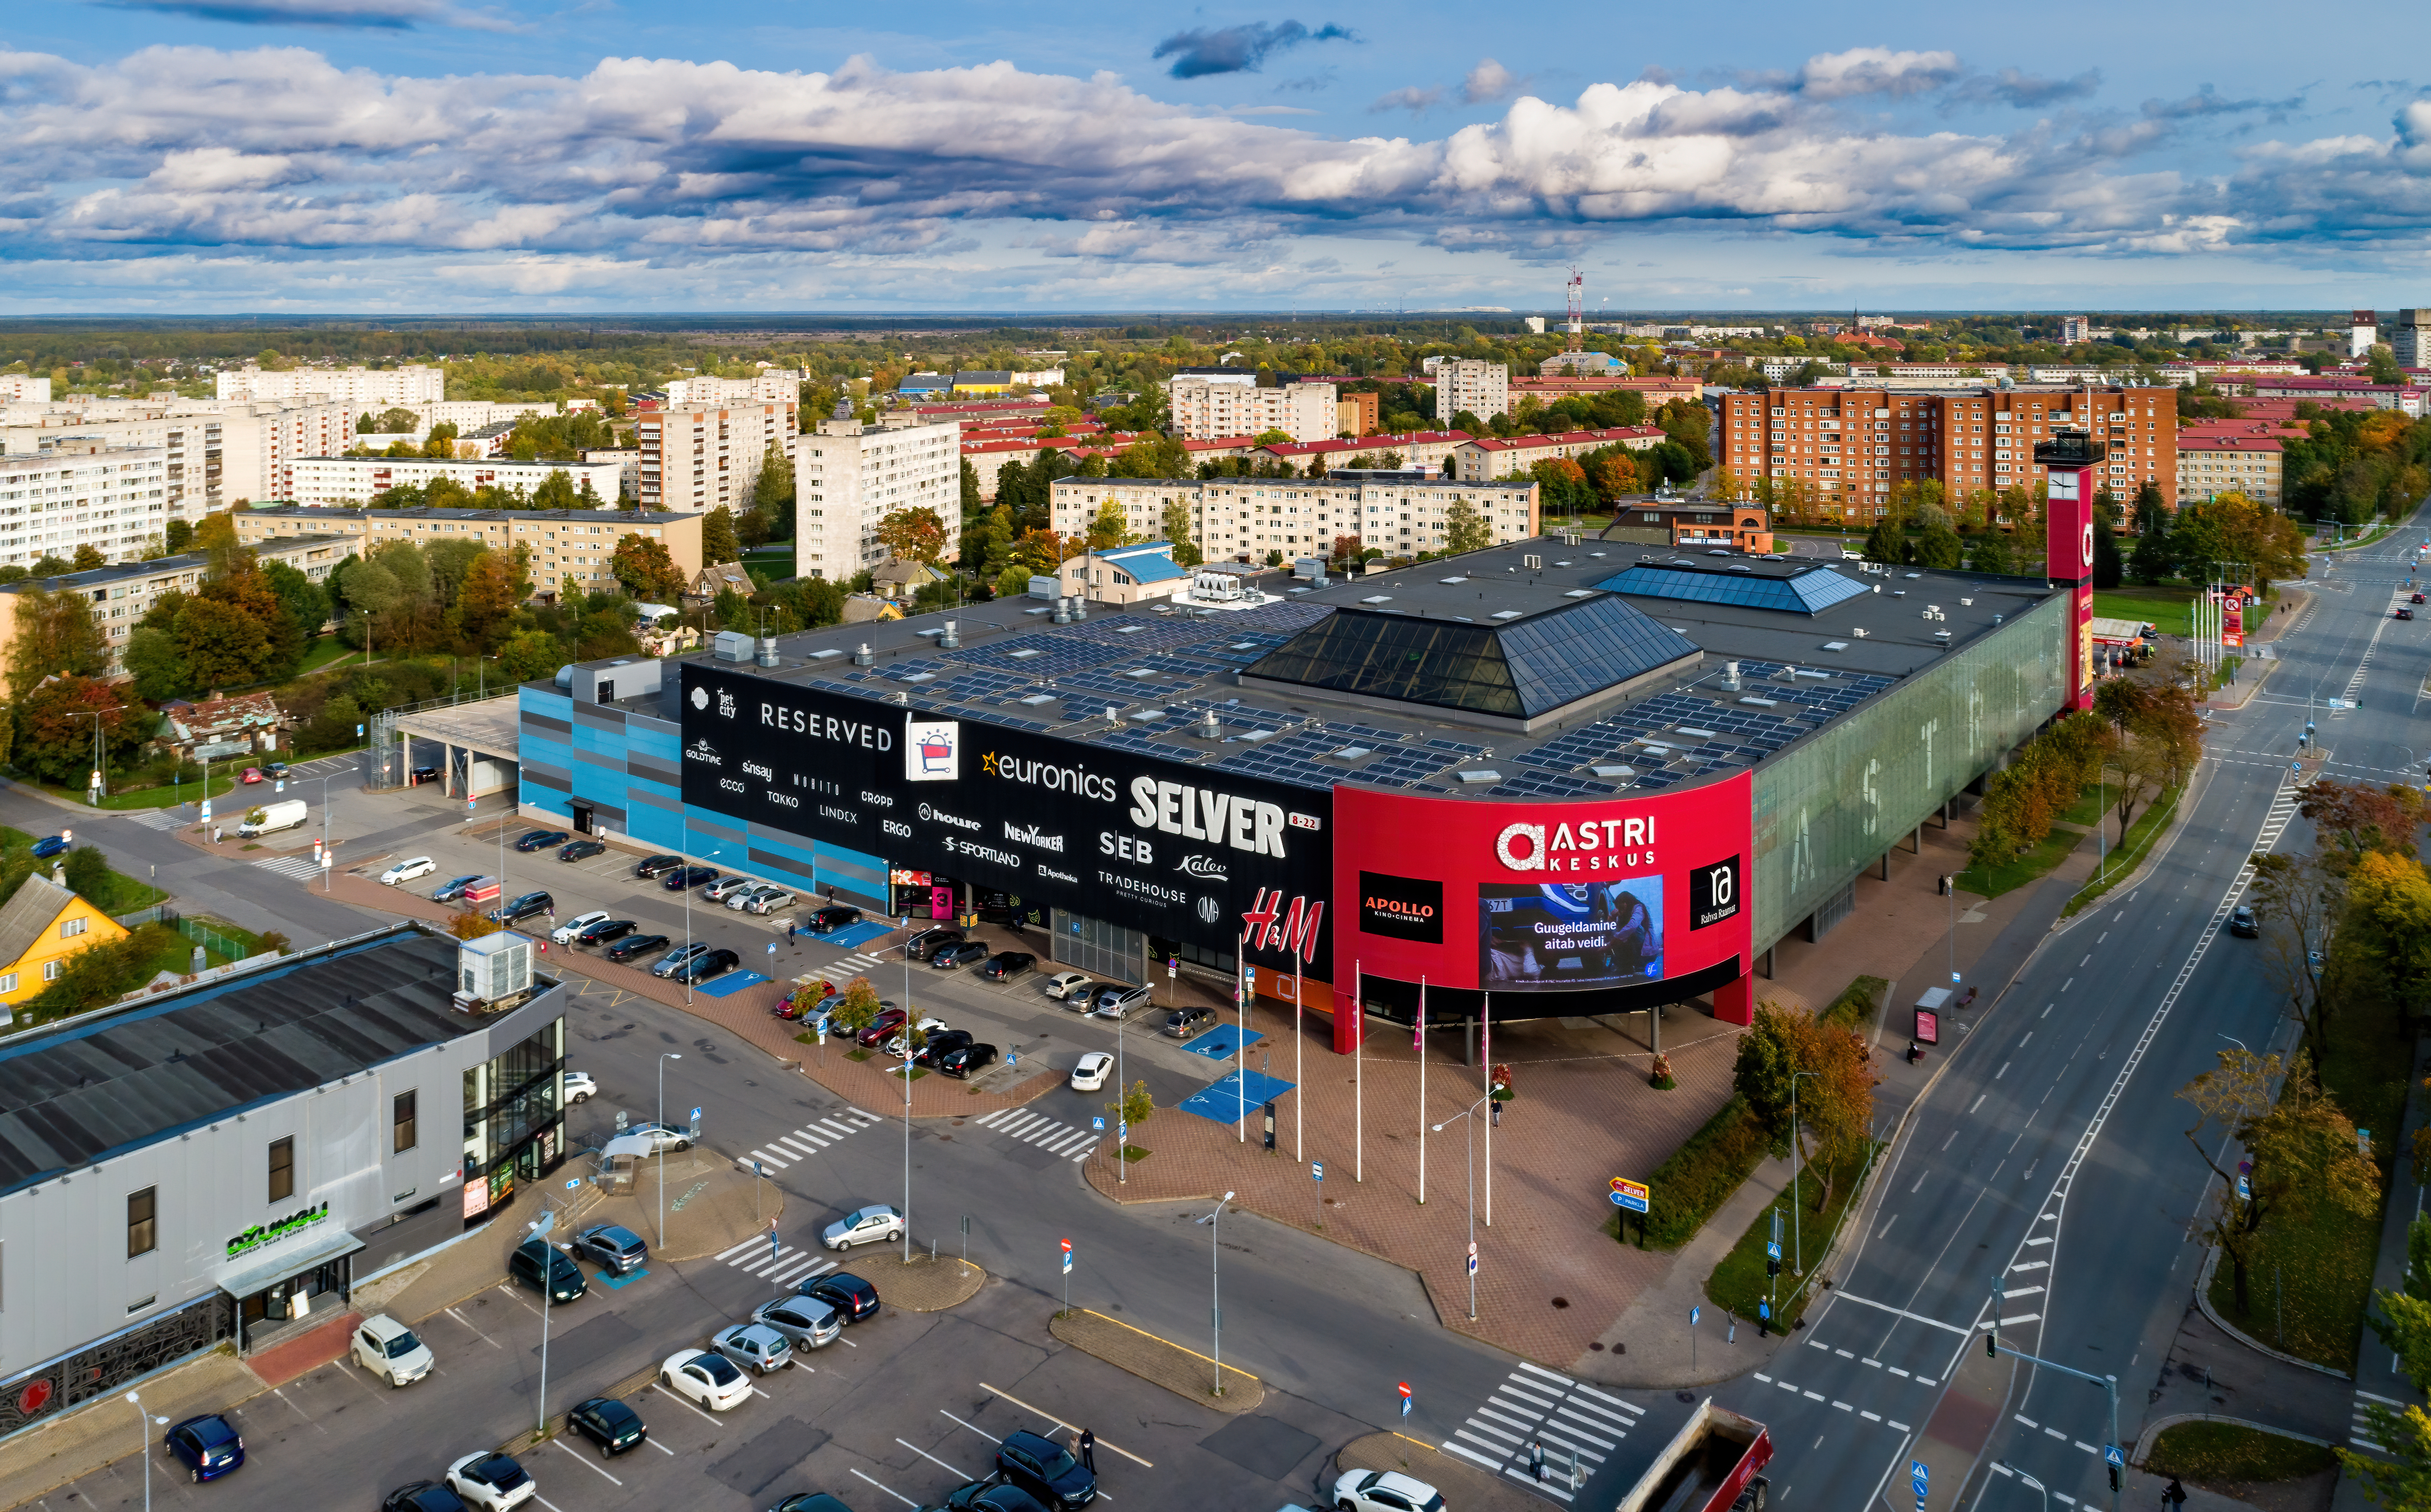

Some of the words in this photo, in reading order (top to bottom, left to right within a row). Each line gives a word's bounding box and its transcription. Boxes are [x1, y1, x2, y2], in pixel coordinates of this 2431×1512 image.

[720, 693, 733, 705] pet
[720, 704, 736, 718] city
[762, 703, 892, 751] RESERVED
[686, 749, 721, 765] GOLDTIME
[742, 760, 772, 782] sinsay
[999, 755, 1116, 802] euronics
[720, 778, 744, 793] ecco
[794, 774, 839, 796] MOHITO
[861, 791, 893, 808] CROPP
[820, 805, 857, 824] LINDEX
[933, 809, 981, 830] house
[1130, 776, 1286, 858] SELVER
[1292, 816, 1315, 828] 8-22
[883, 820, 911, 837] ERGO
[1550, 816, 1655, 851] ASTRI
[959, 841, 1020, 867] SPORTLAND
[1549, 851, 1655, 871] KESKUS
[1047, 869, 1078, 883] Apotheka
[1173, 855, 1228, 881] Kalev
[1098, 871, 1186, 904] TRADEHOUSE
[936, 893, 947, 907] 3
[1116, 890, 1138, 900] PRETTY
[1140, 897, 1167, 908] CURIOUS
[1365, 897, 1433, 917] APOLLO
[1198, 896, 1218, 923] OMA
[1701, 912, 1718, 924] Rahva
[1241, 887, 1325, 964] H&M
[1534, 920, 1617, 936] Guugeldamine
[1545, 938, 1575, 950] aitab
[1577, 936, 1607, 948] veidi.
[818, 1020, 824, 1029] P
[1120, 1125, 1124, 1136] P
[1623, 1186, 1644, 1198] SELVER
[1624, 1199, 1644, 1209] PARKLA
[1065, 1254, 1070, 1264] P
